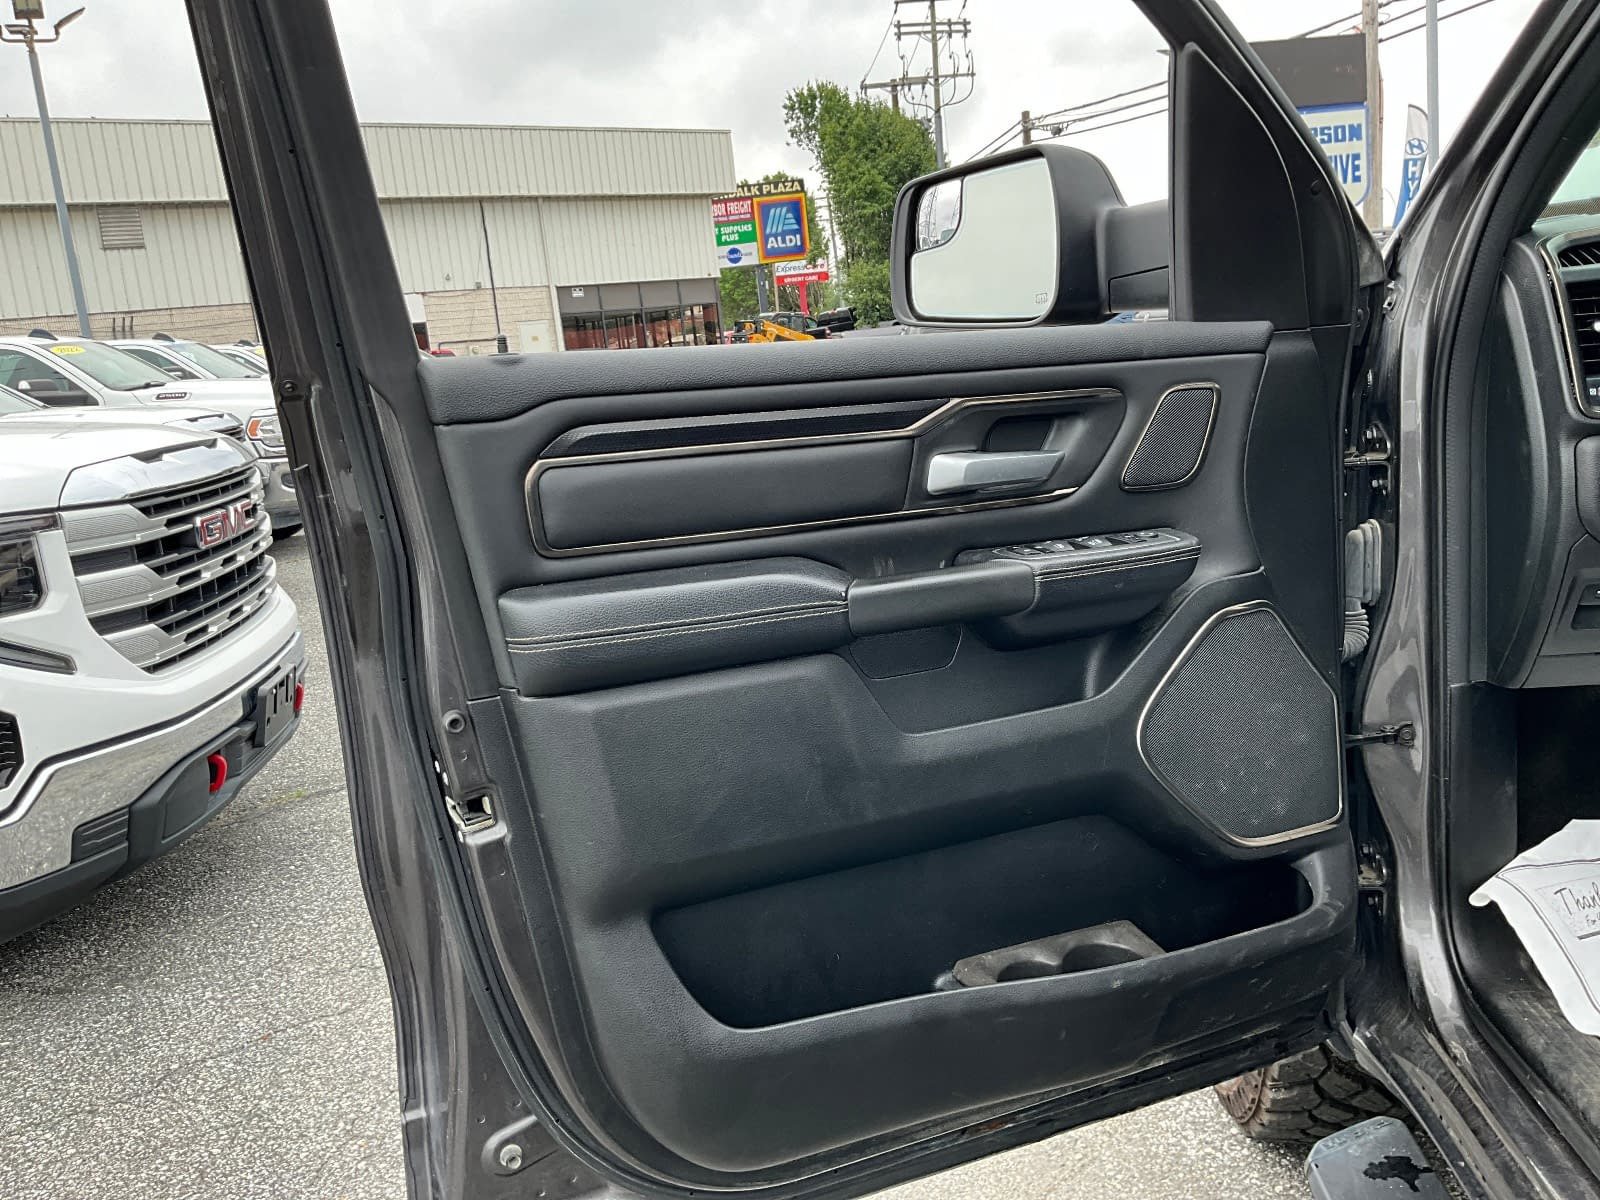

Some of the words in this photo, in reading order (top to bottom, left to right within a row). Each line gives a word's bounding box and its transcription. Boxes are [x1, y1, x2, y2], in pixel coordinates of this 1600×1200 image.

[762, 181, 801, 195] PLAZA
[727, 201, 752, 215] FREIGHT
[721, 233, 739, 242] PLUS
[767, 234, 801, 249] ALDI
[197, 499, 257, 548] GMC
